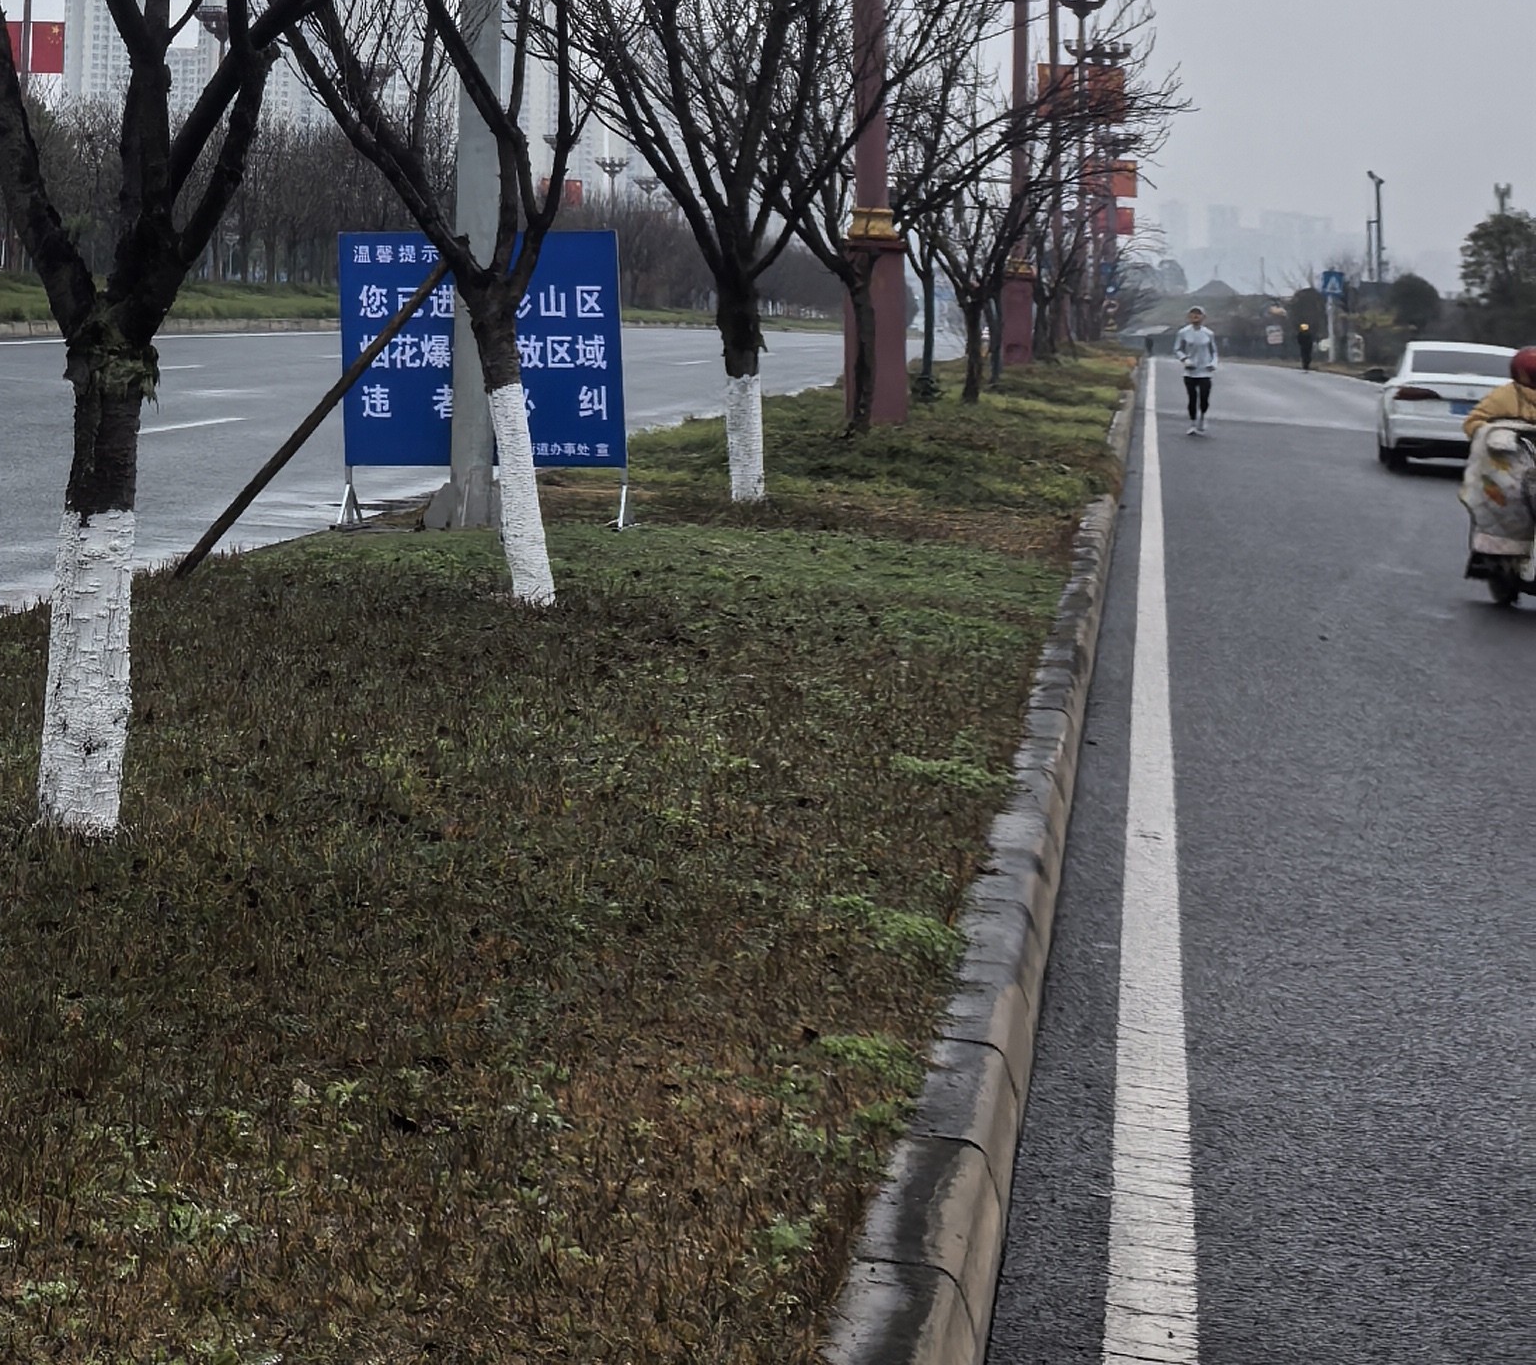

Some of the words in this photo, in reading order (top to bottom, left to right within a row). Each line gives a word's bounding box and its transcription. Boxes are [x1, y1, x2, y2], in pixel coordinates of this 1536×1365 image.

[353, 244, 441, 264] 温馨提示
[359, 284, 605, 319] 您已进山区
[359, 334, 607, 370] 烟花爆放区域
